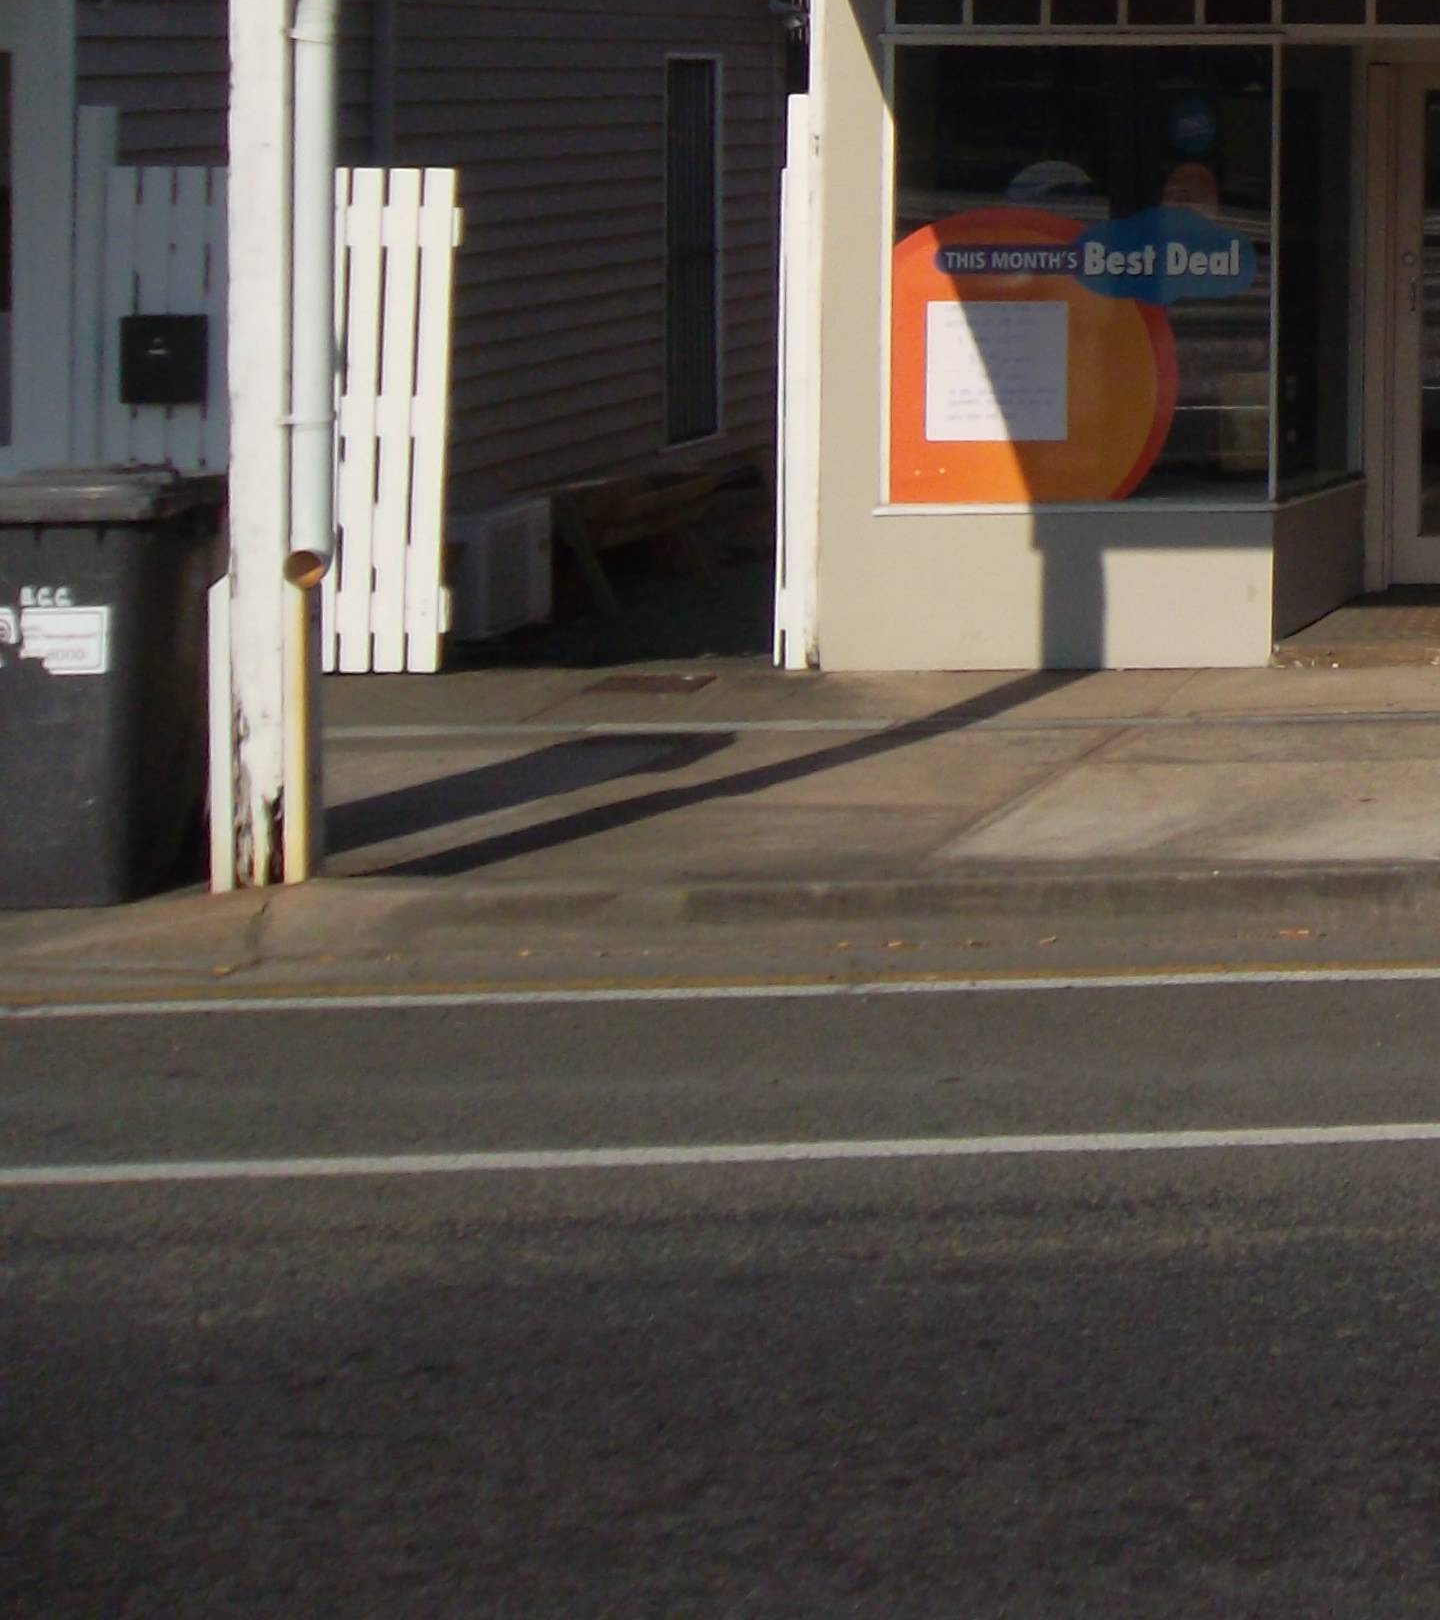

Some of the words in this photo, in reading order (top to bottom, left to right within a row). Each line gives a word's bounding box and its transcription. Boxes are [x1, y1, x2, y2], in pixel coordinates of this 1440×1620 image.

[946, 251, 986, 269] THIS
[992, 250, 1077, 269] MONTH'S
[1084, 241, 1156, 276] Best
[1167, 239, 1240, 276] Deal
